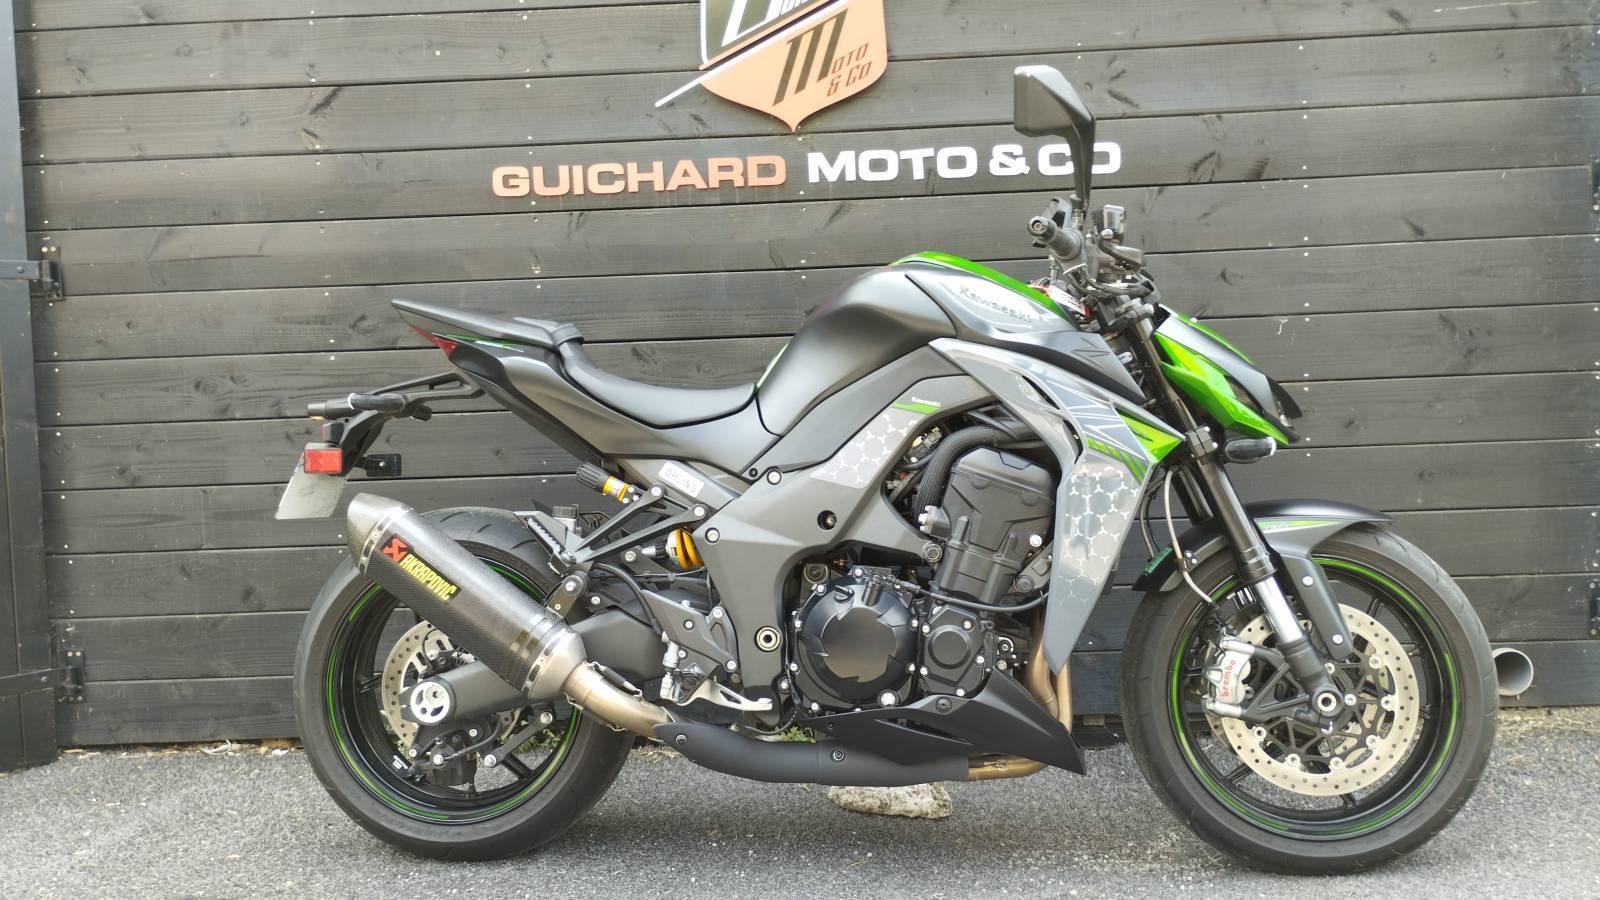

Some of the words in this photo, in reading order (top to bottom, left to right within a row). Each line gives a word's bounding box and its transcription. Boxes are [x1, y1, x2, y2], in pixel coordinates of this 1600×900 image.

[491, 154, 787, 197] GUICHARD
[807, 146, 978, 183] MOTO
[988, 144, 1030, 176] &
[1037, 142, 1121, 176] CO
[1221, 659, 1236, 697] brembo
